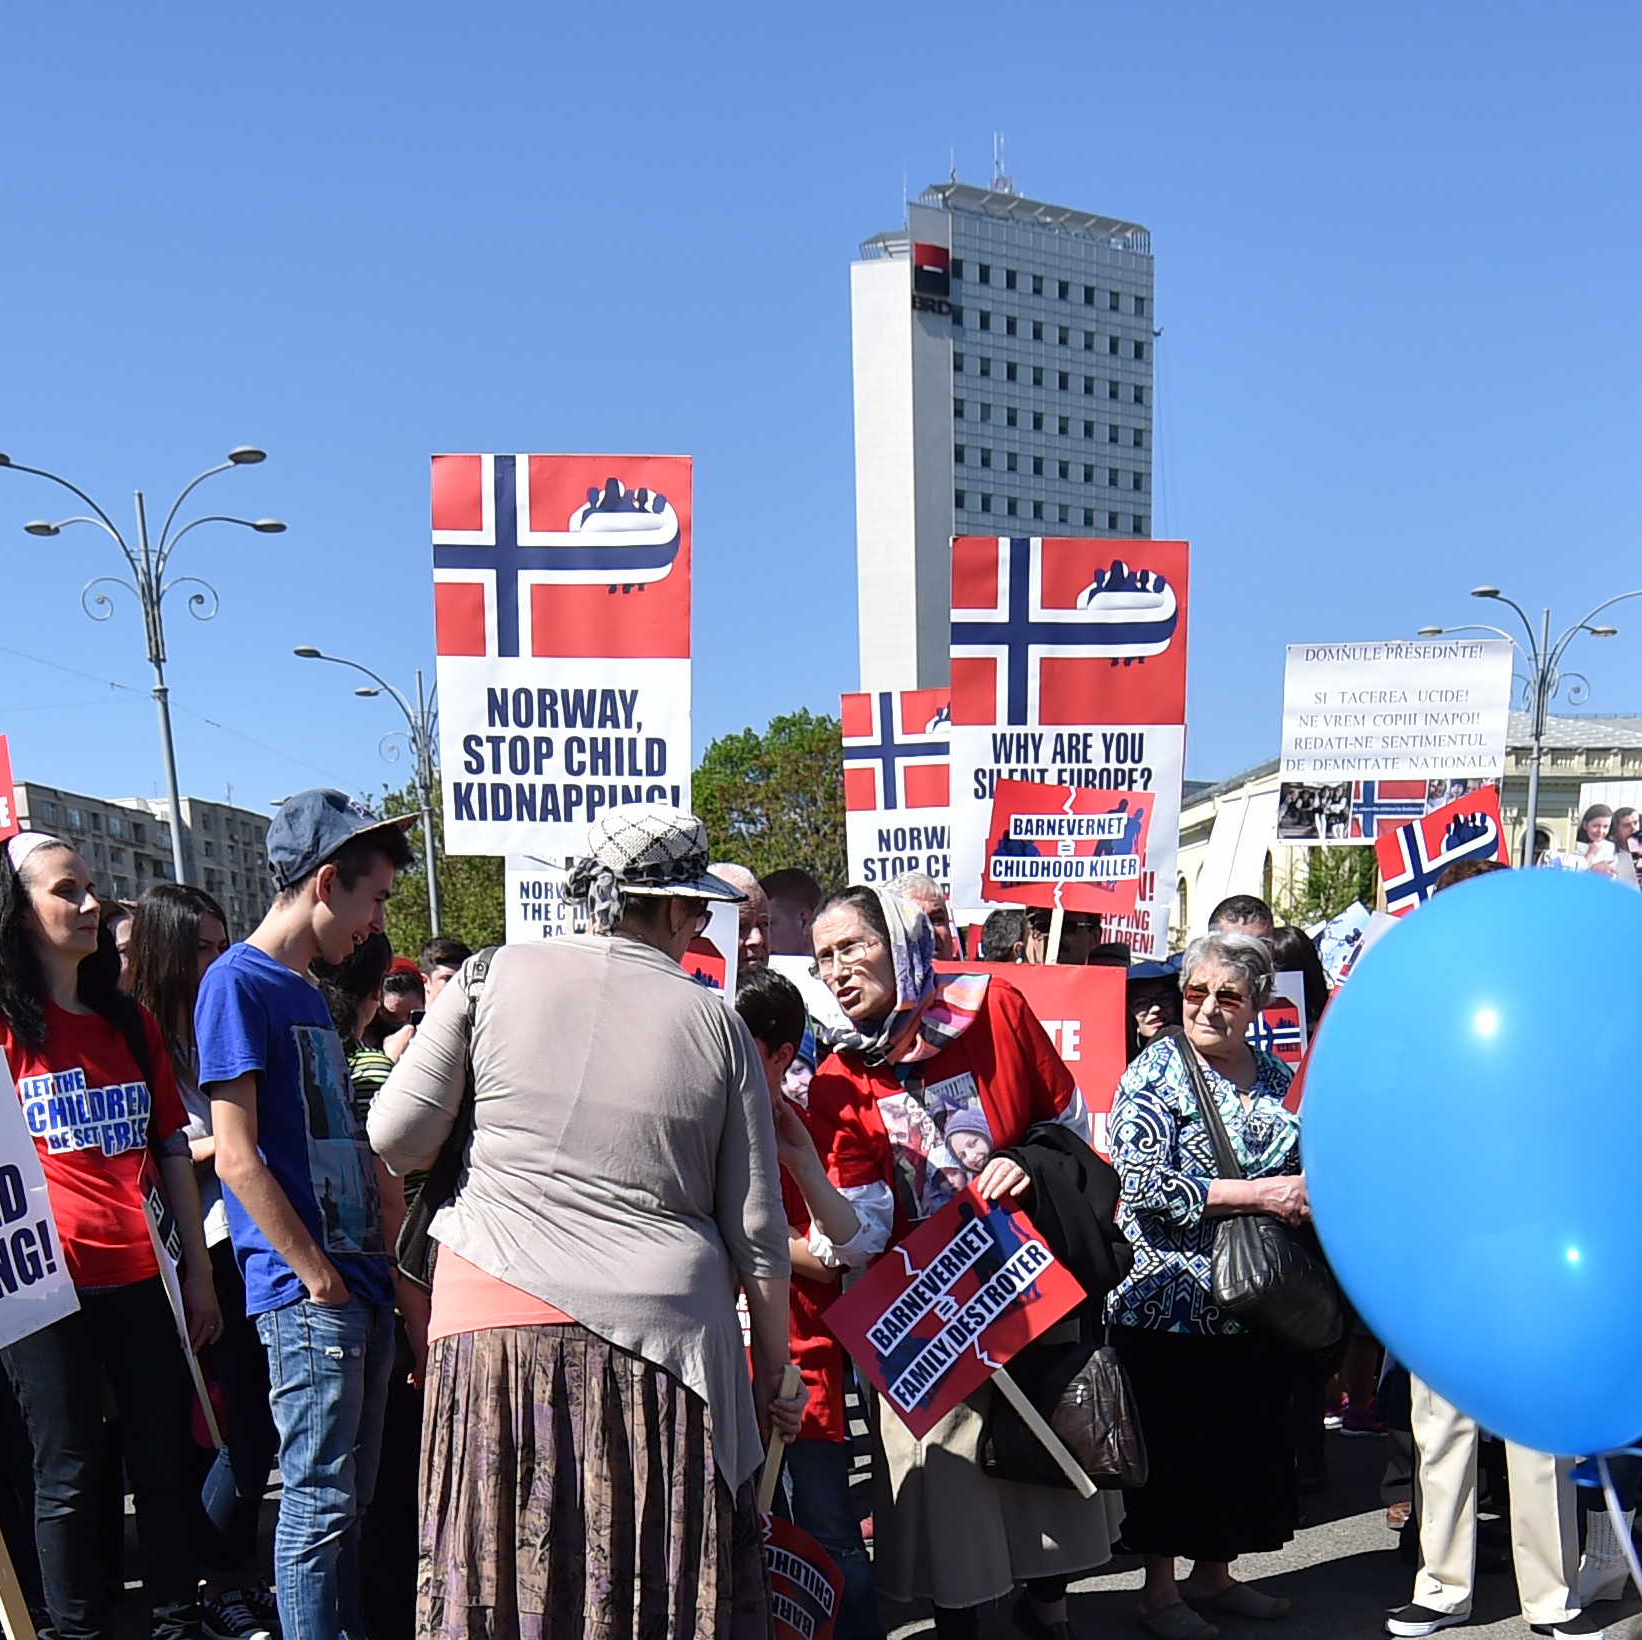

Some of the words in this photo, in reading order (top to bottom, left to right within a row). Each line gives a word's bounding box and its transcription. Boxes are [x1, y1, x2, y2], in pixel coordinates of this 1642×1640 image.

[912, 294, 952, 316] BRD
[1305, 647, 1382, 662] DOMNULE
[1385, 645, 1483, 661] PRESEDINTE!
[1314, 691, 1327, 704] SI
[1339, 690, 1407, 704] TACEREA
[1418, 689, 1469, 703] UCIDE!
[487, 687, 643, 733] NORWAY,
[1299, 715, 1318, 728] NE
[1323, 714, 1365, 727] VREM
[1373, 713, 1417, 727] COPIII
[1424, 712, 1480, 725] INAPOI!
[992, 732, 1043, 764] WHY
[1051, 733, 1093, 763] ARE
[1101, 732, 1144, 764] YOU
[1294, 736, 1374, 750] REDATI-NE
[1382, 733, 1487, 748] SENTIMENTUL
[463, 734, 554, 776] STOP
[564, 736, 667, 777] CHILD
[1286, 759, 1305, 771] DE
[1313, 757, 1400, 771] DEMNITATE
[1409, 755, 1497, 769] NATIONALA
[878, 825, 950, 852] NORW
[1013, 817, 1124, 836] BARNEVERNET
[992, 859, 1085, 878] CHILDHOOD
[1089, 858, 1137, 876] KILLER
[521, 903, 552, 921] THE
[24, 1077, 51, 1099] LET
[54, 1071, 85, 1094] THE
[27, 1084, 149, 1133] CHILDREN
[48, 1133, 71, 1149] BE
[73, 1127, 99, 1147] SET
[100, 1117, 148, 1155] FREE
[870, 1222, 989, 1350] BARNEVERNET
[893, 1337, 953, 1407] FAMILY
[950, 1243, 1048, 1348] DESTROYER
